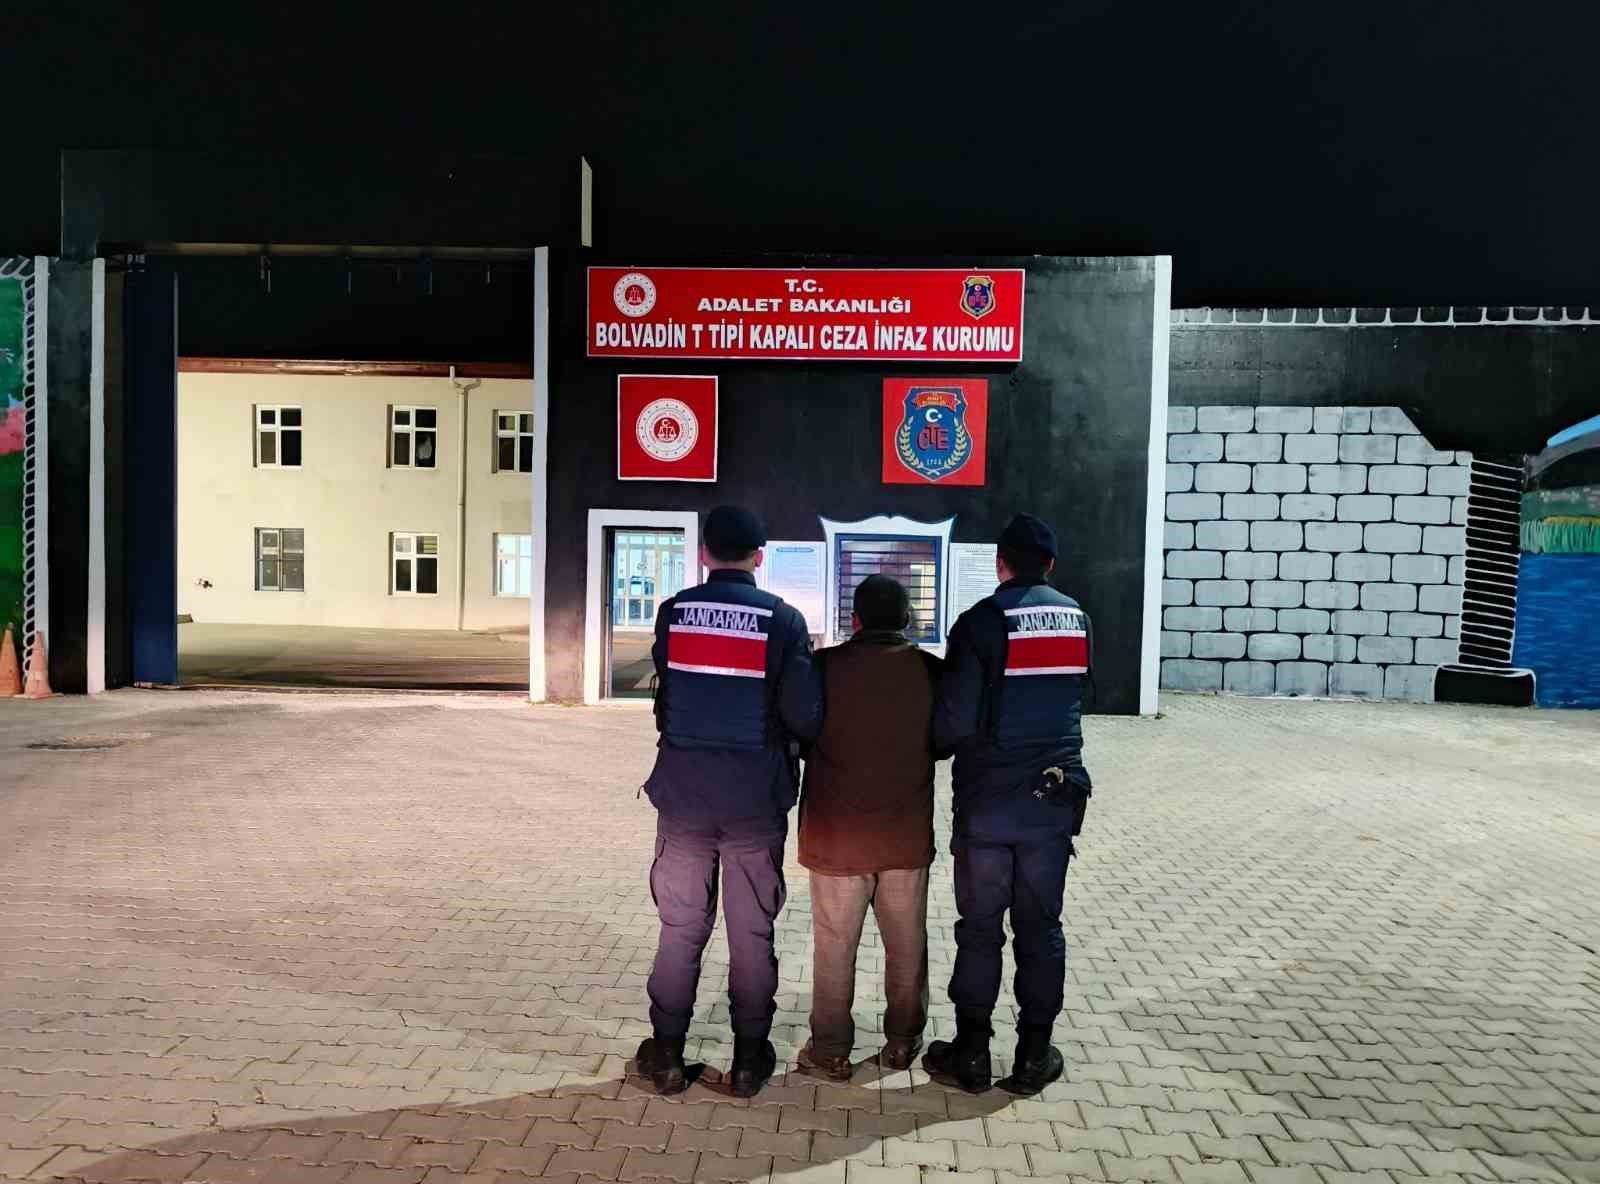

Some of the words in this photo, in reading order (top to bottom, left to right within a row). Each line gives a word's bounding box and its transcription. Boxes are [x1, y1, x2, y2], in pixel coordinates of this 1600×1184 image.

[784, 278, 824, 293] T.C.
[697, 297, 783, 312] ADALET
[789, 296, 911, 313] BAKANLIĞI
[595, 317, 686, 348] BOLVADİN
[692, 324, 703, 349] T
[708, 318, 743, 349] TİPİ
[750, 324, 815, 350] KAPALI
[820, 325, 868, 350] CEZA
[874, 320, 928, 351] İNFAZ
[932, 326, 1014, 352] KURUMU
[679, 607, 759, 632] JANDARMA
[1017, 612, 1081, 632] JANDARMA
